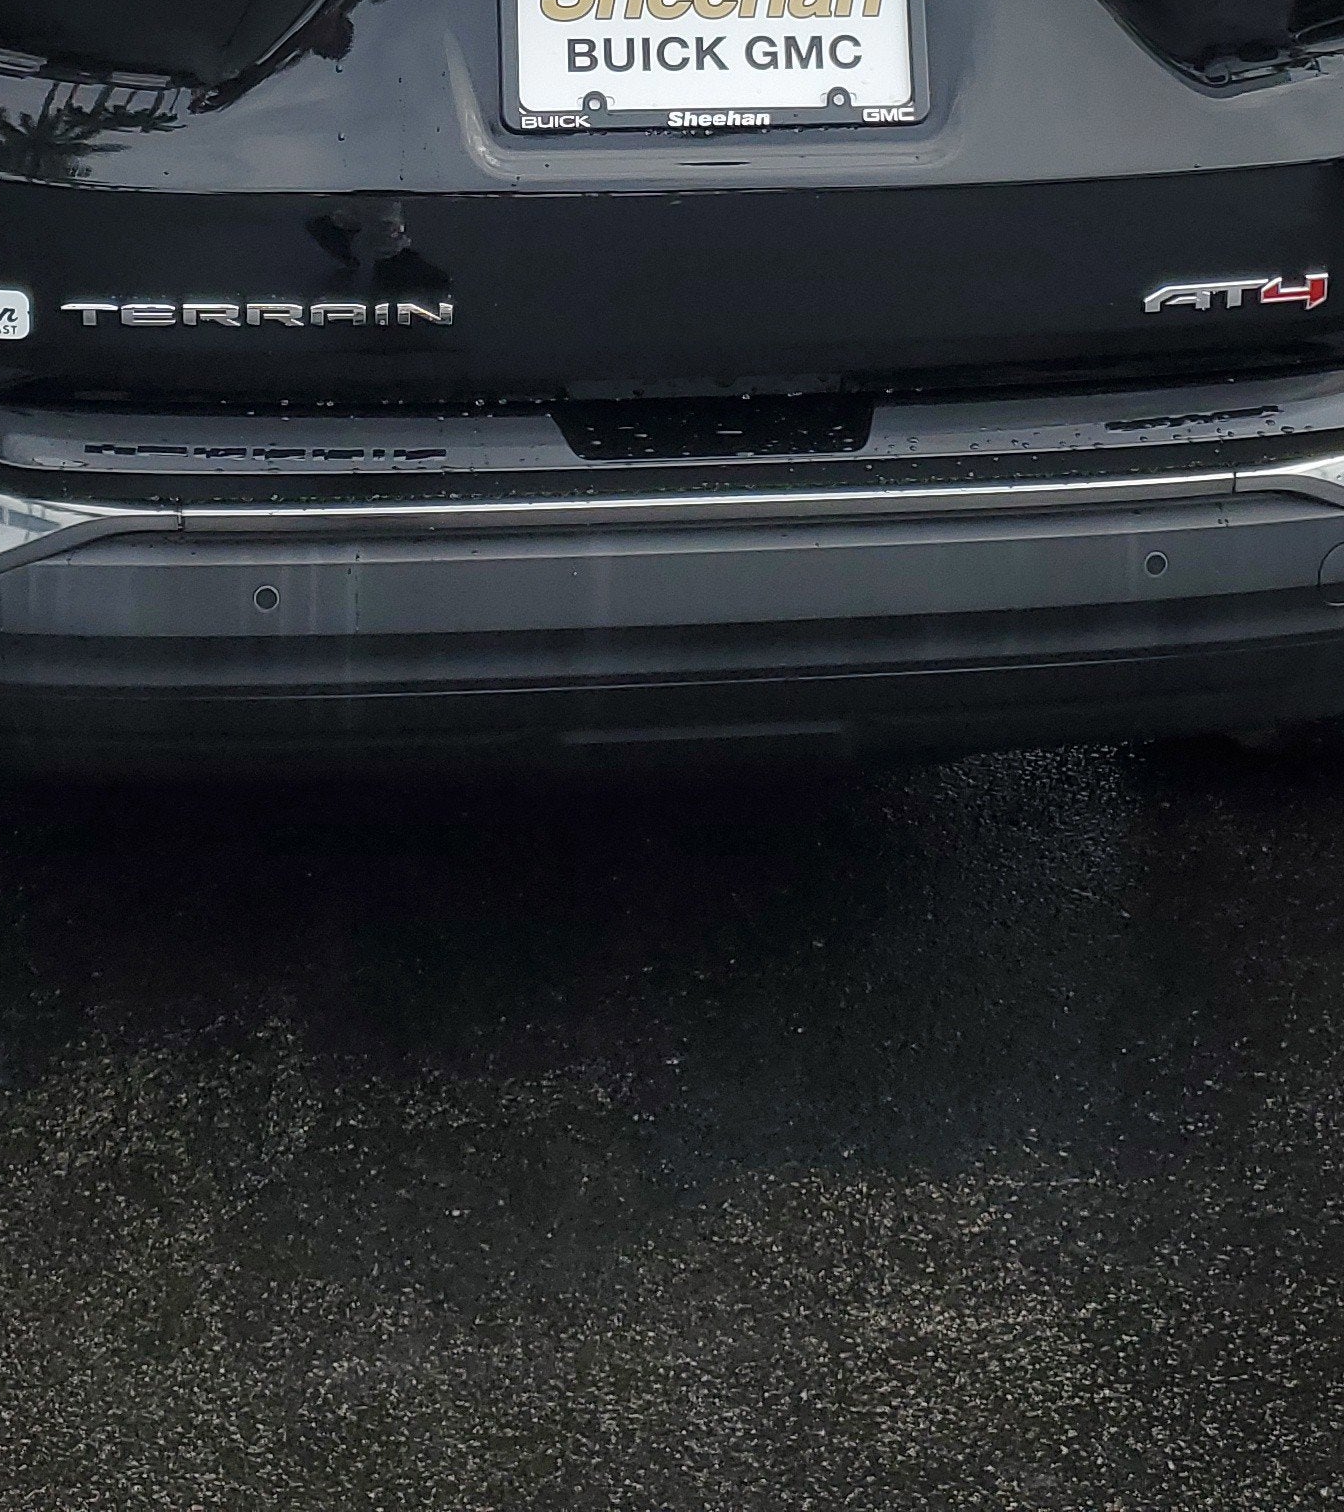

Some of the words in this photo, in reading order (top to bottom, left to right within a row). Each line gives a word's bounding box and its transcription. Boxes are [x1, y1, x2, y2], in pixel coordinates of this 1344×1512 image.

[567, 36, 729, 73] BUICK
[745, 34, 862, 70] GMC
[521, 114, 591, 129] BUICK
[667, 111, 770, 127] Sheehan
[862, 106, 915, 122] GMC
[1144, 272, 1329, 313] AT4
[61, 301, 454, 327] TERRAIN
